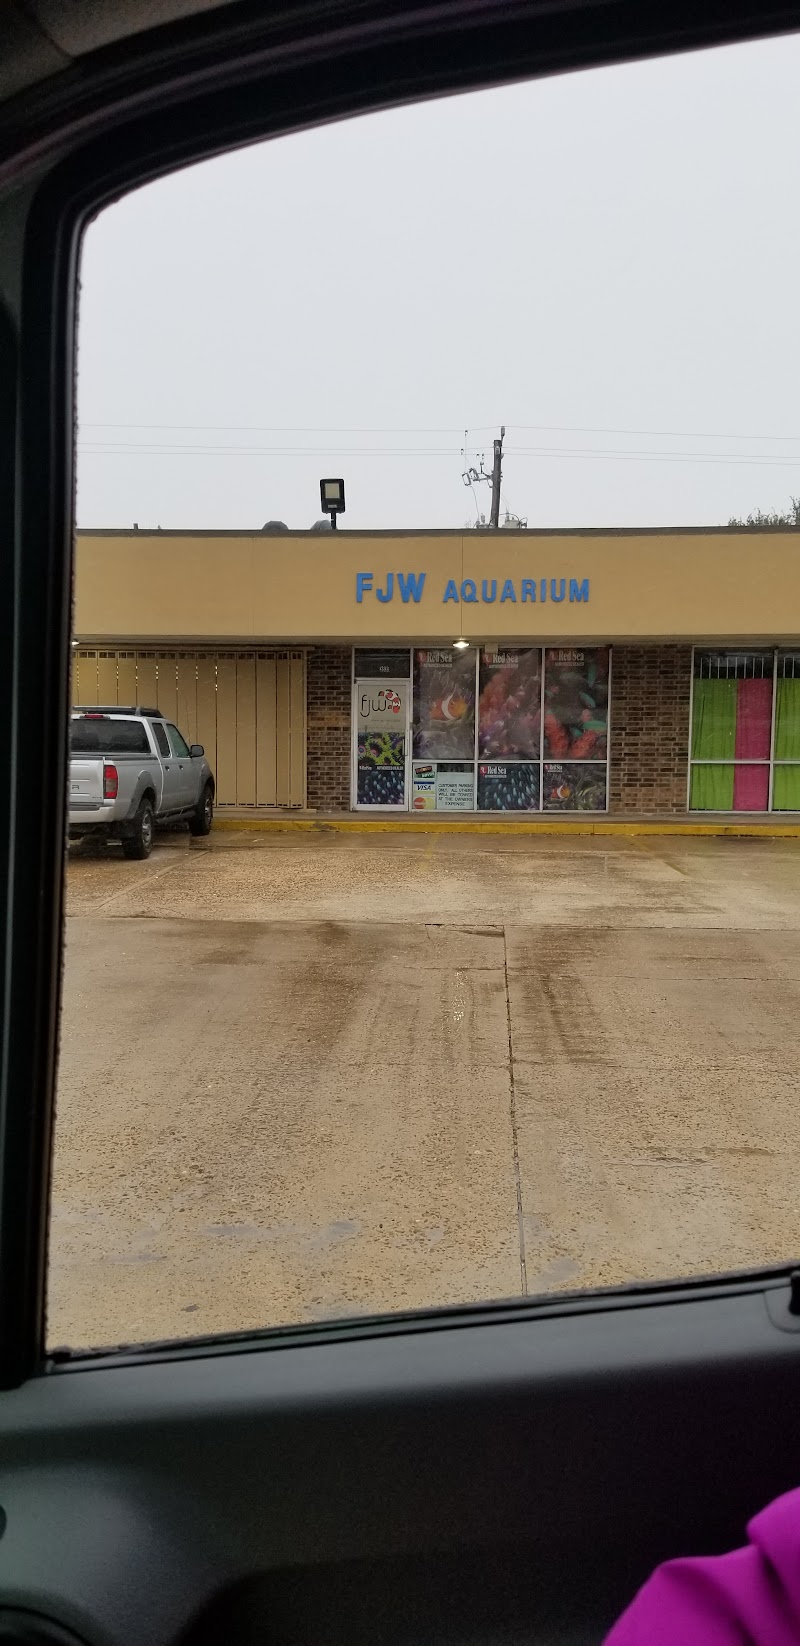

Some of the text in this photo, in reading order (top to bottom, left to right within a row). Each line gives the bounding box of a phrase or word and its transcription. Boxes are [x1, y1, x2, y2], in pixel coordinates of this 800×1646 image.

[356, 572, 590, 603] FJW AQUARIUM
[427, 652, 452, 662] Red Sea
[493, 653, 518, 663] Red Sea
[558, 651, 585, 661] Red Sea
[360, 694, 386, 718] fjw
[487, 765, 506, 774] Red Sea
